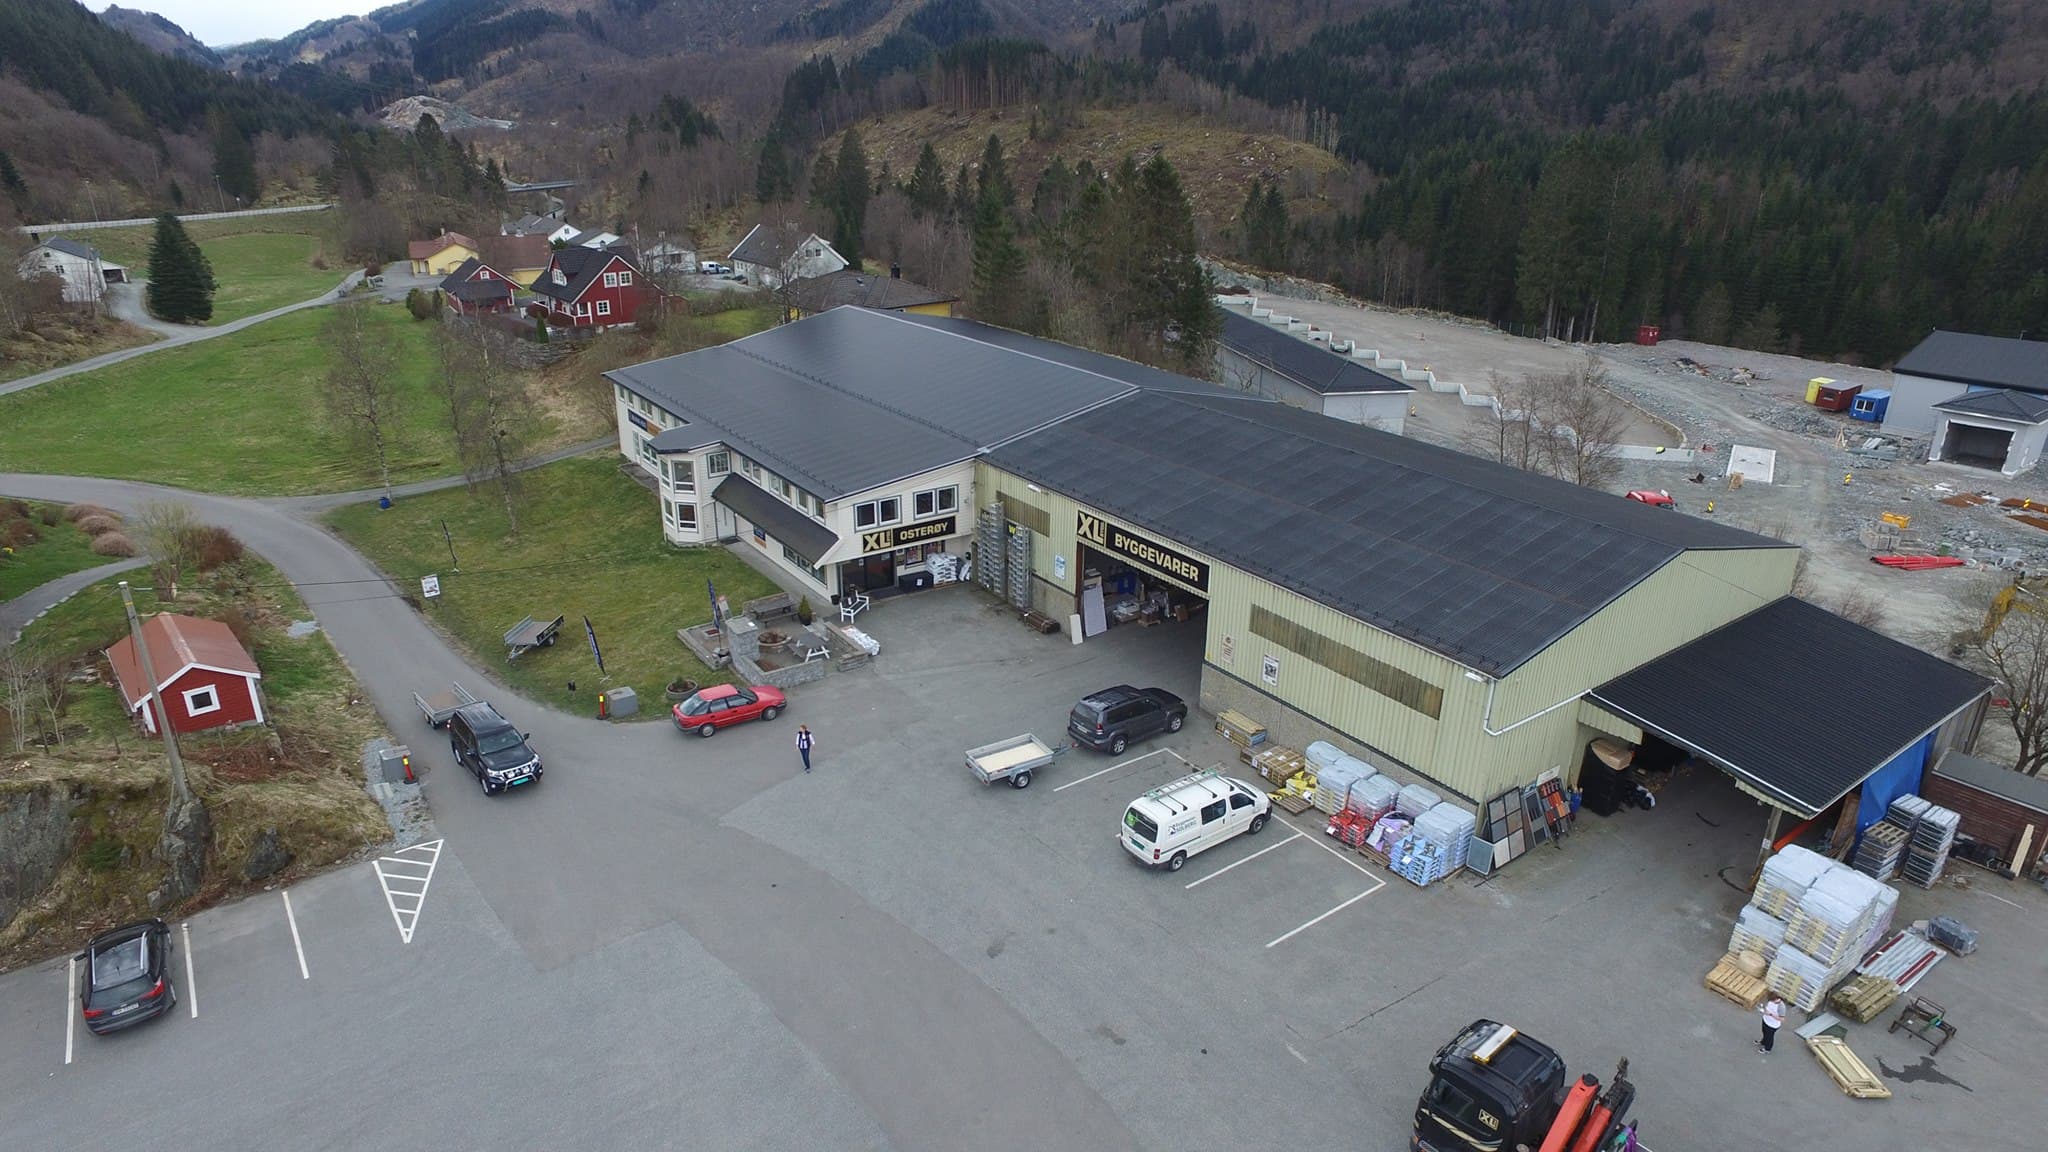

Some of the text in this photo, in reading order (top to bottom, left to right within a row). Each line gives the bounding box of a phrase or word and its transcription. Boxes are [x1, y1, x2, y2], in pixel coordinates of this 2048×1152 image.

[864, 532, 891, 552] XL
[899, 522, 948, 541] OSTERØY
[1078, 512, 1104, 545] XL
[1114, 533, 1200, 582] BYGGEVARER
